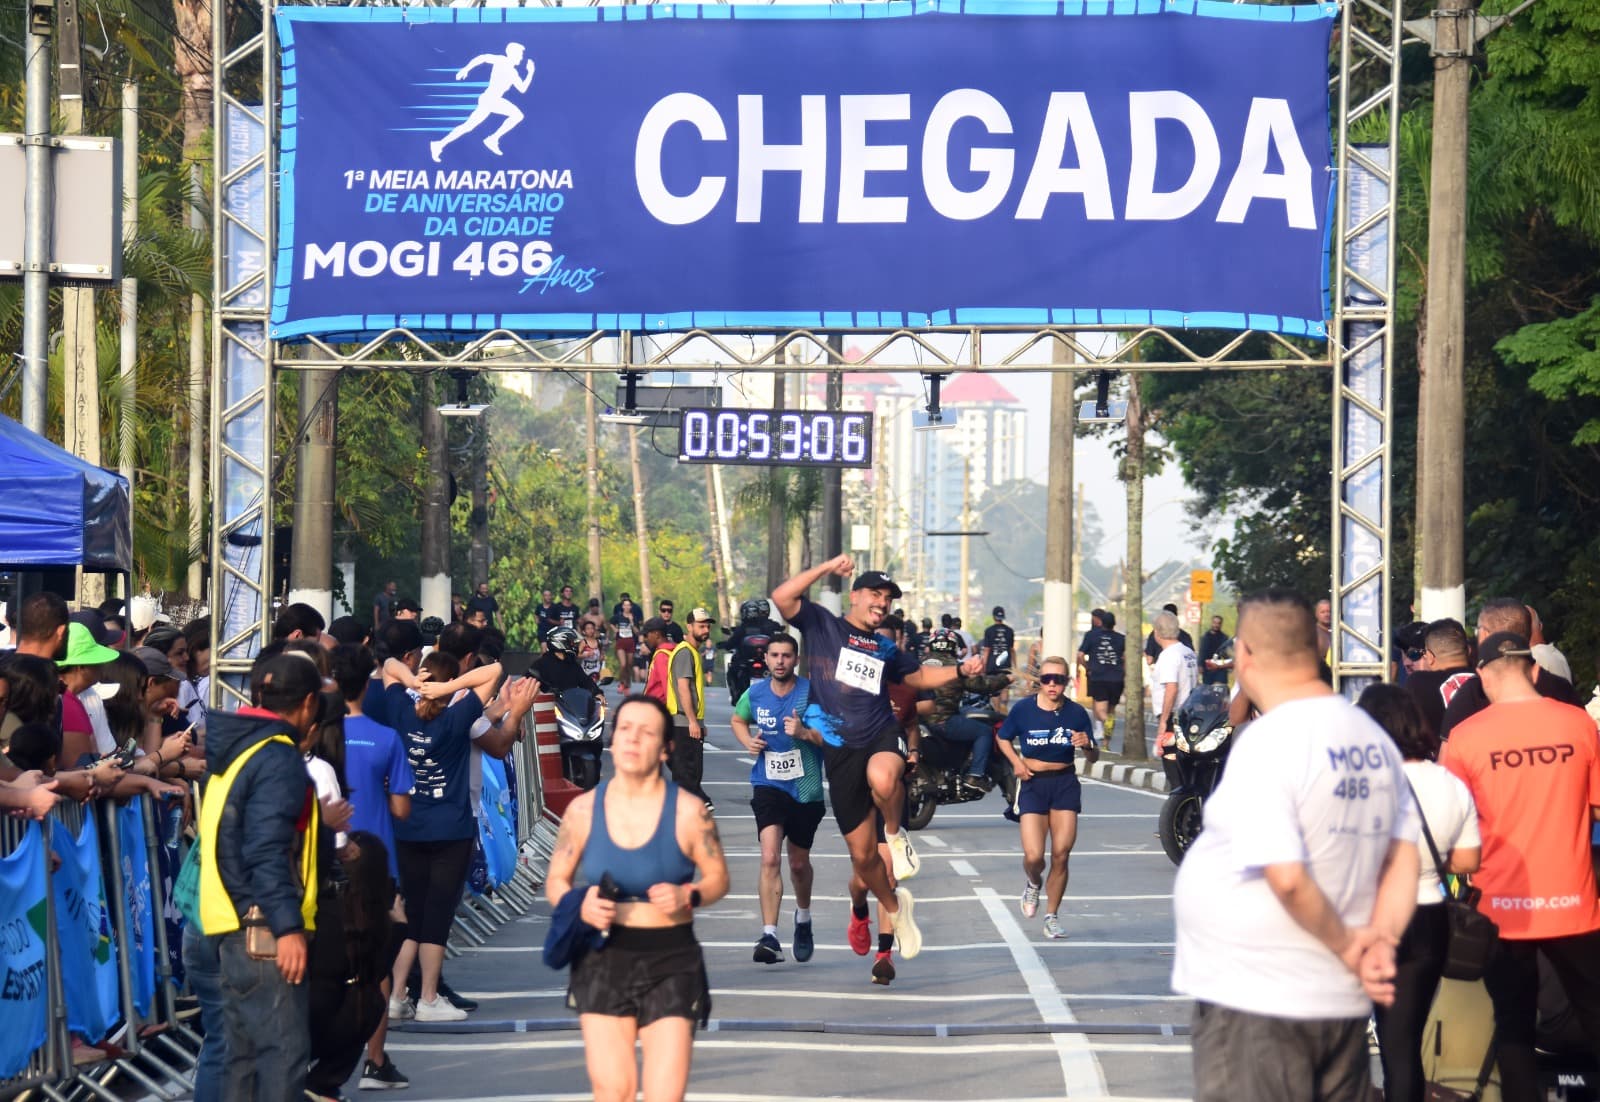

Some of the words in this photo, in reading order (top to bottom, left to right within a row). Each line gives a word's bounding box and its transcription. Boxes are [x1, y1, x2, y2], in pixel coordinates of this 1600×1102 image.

[634, 88, 1318, 229] CHEGADA
[343, 169, 365, 190] 1ª
[368, 169, 430, 190] MEIA
[433, 169, 574, 191] MARATONA
[364, 192, 398, 214] DE
[400, 187, 565, 214] ANIVERSÁRIO
[423, 215, 460, 238] DA
[463, 215, 555, 238] CIDADE
[303, 240, 441, 281] MOGI
[452, 240, 553, 278] 466
[517, 253, 603, 296] Anos
[685, 411, 866, 462] 00:53:06
[846, 660, 876, 679] 5628
[757, 706, 770, 717] faz
[1026, 737, 1048, 746] MOGI
[770, 758, 796, 771] 5202
[1326, 743, 1391, 772] MOGI
[1490, 744, 1575, 771] FOTOP
[1333, 776, 1370, 801] 466
[1491, 895, 1581, 910] FOTOP.COM
